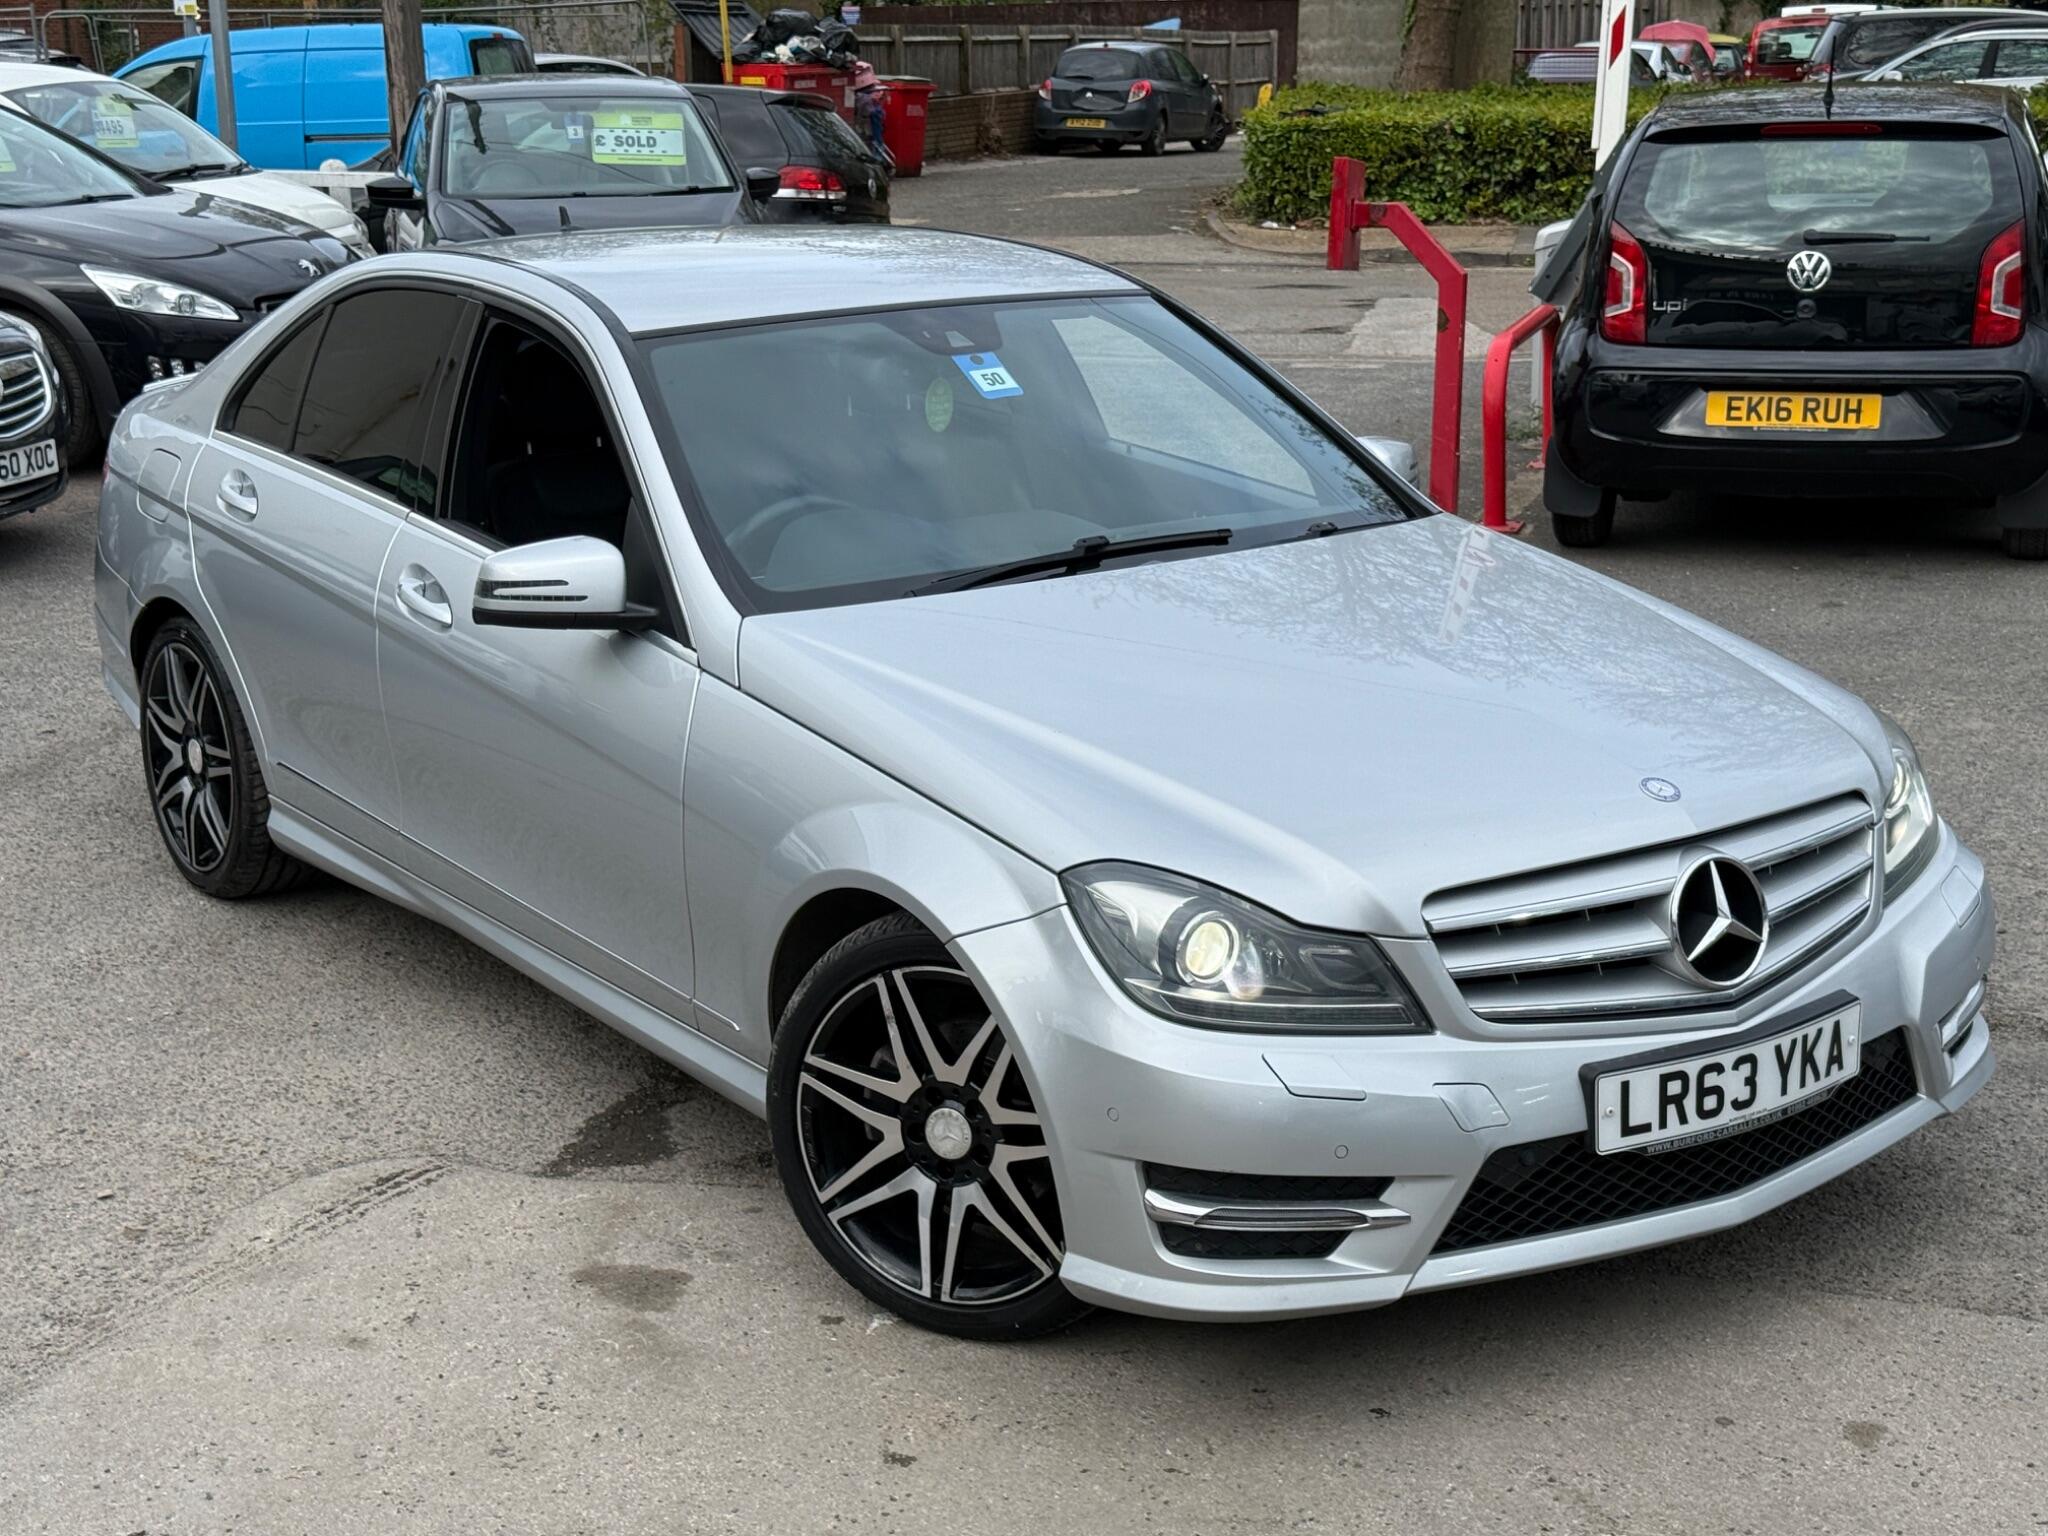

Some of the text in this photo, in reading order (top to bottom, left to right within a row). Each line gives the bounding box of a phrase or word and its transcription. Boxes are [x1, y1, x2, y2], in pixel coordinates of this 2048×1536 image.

[595, 135, 657, 148] £ SOLD
[981, 372, 1006, 387] 50
[1725, 396, 1863, 424] EK16 RUH
[24, 443, 55, 474] XOC
[1620, 1019, 1844, 1138] LR63 YKA
